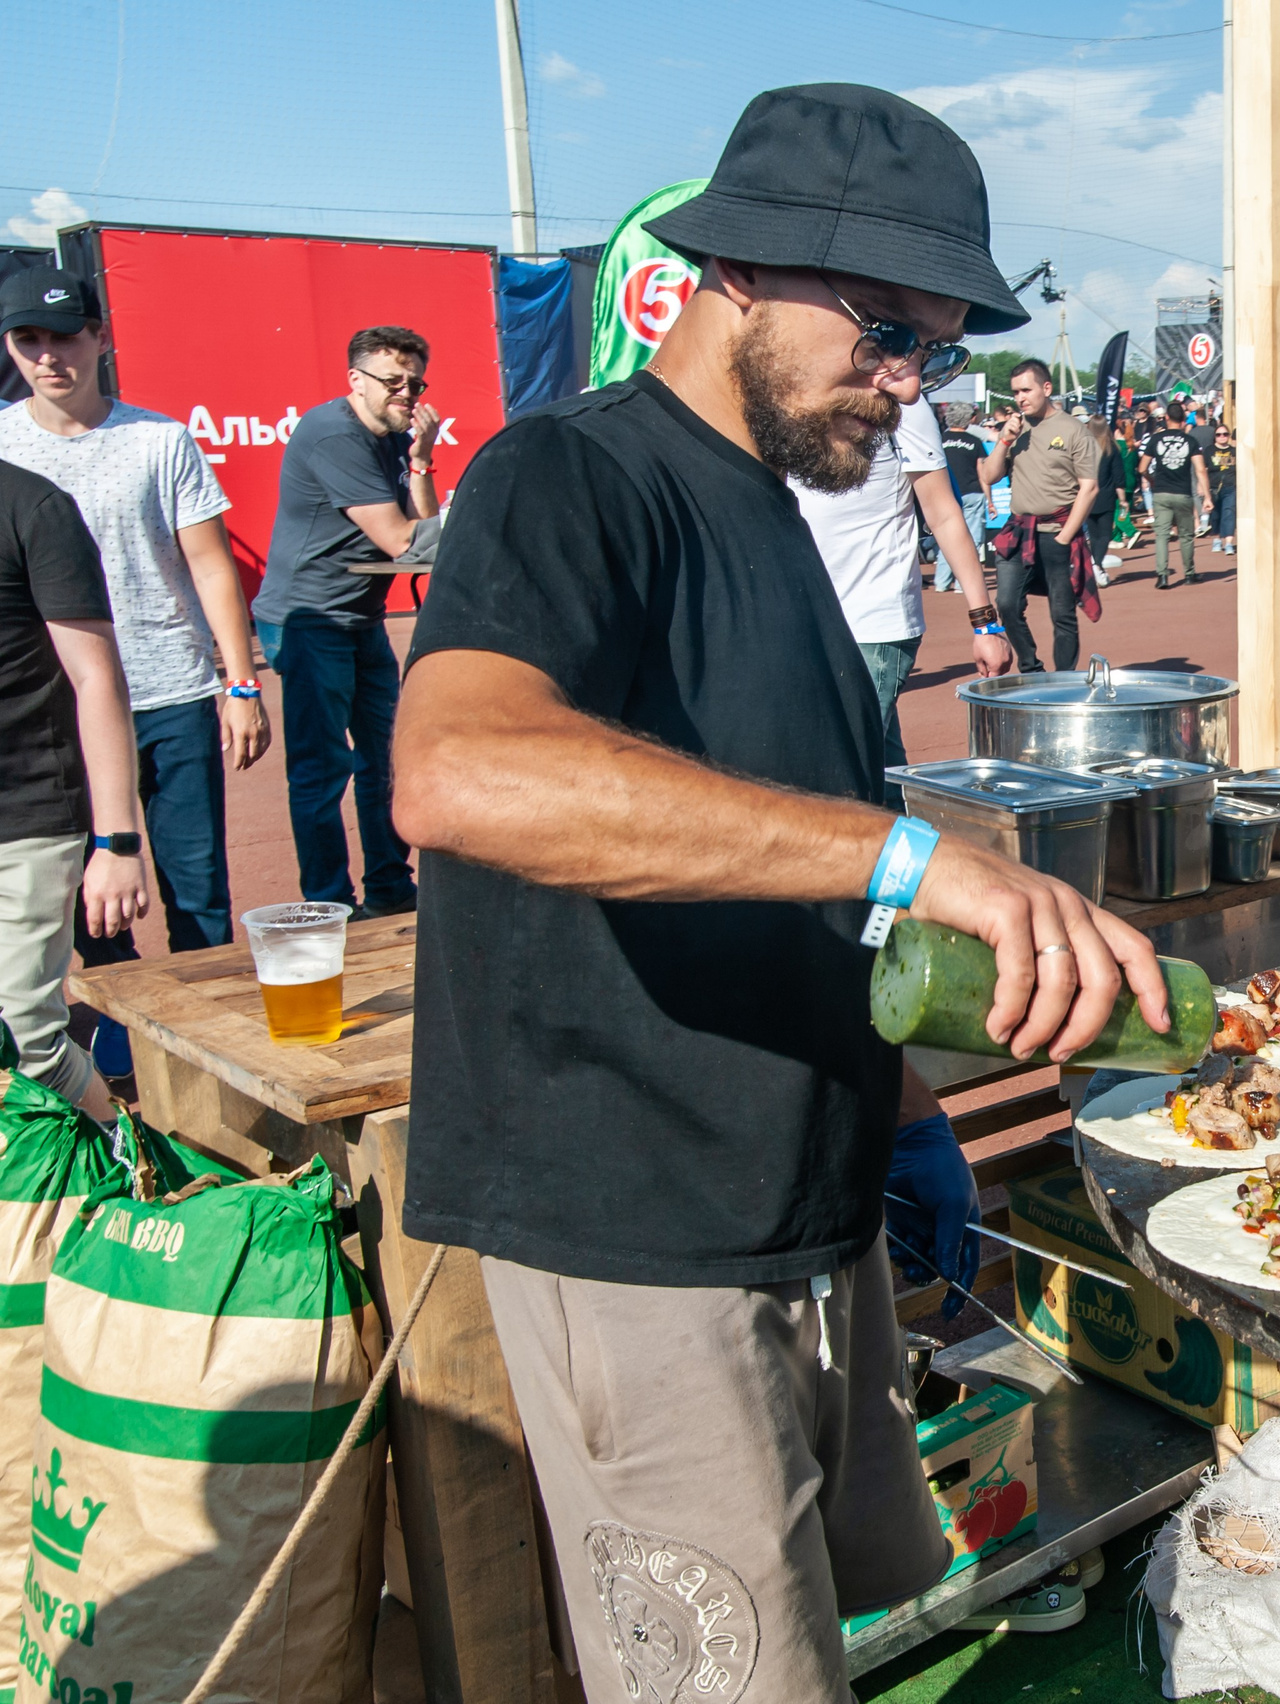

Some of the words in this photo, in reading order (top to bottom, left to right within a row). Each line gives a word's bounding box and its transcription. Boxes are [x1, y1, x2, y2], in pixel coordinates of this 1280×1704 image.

[130, 1217, 185, 1262] BBQ
[1027, 1201, 1073, 1234] Tropical
[1075, 1221, 1120, 1254] Premiu
[24, 1552, 97, 1647] Royal
[19, 1614, 133, 1704] harcoal
